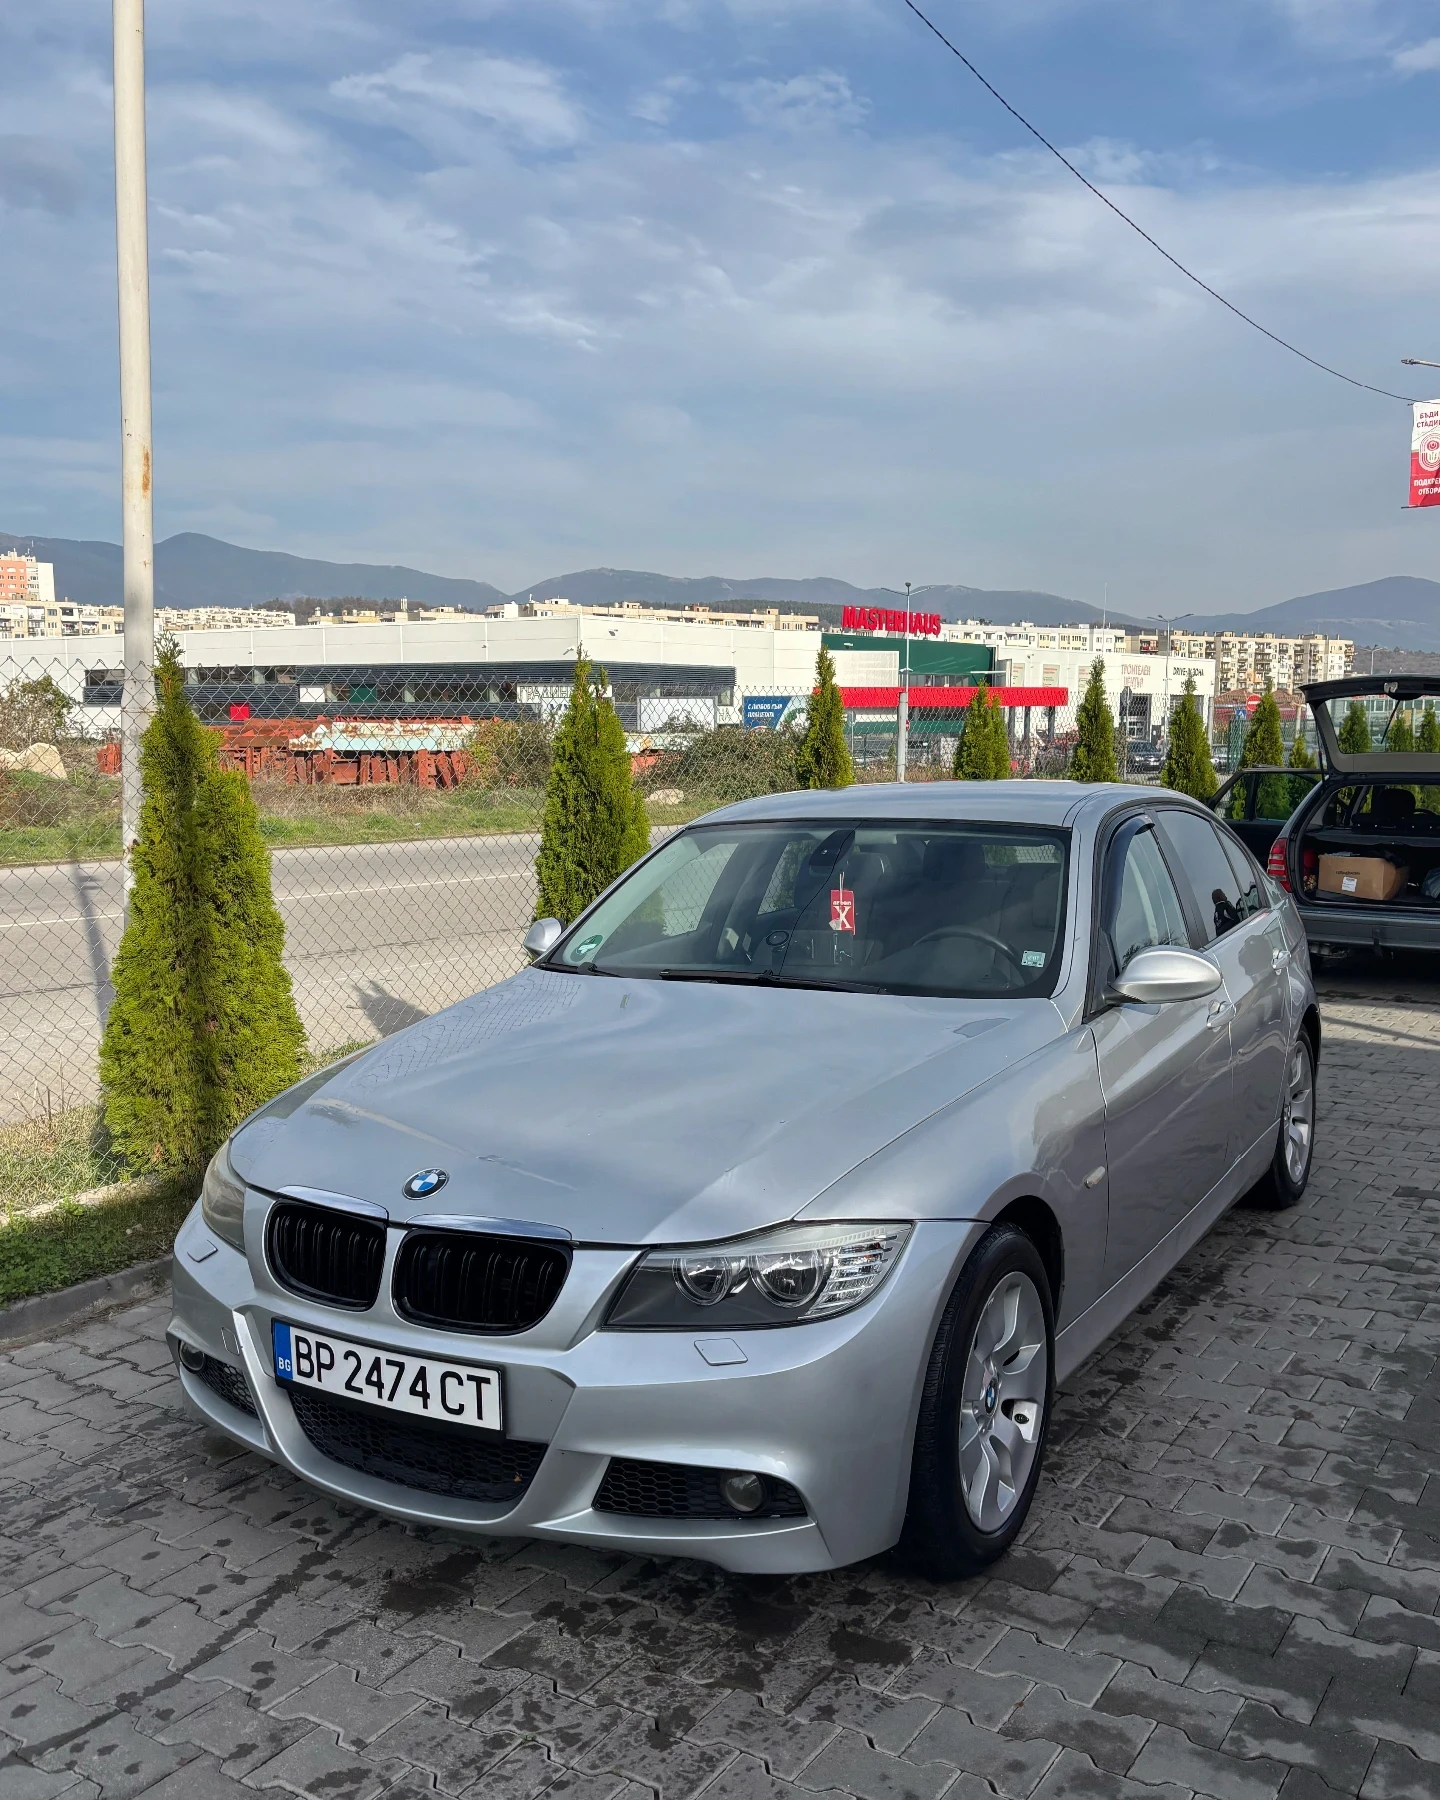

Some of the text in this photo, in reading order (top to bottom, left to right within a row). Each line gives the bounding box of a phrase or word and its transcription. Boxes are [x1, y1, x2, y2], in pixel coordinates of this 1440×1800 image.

[1419, 410, 1439, 419] БЪДИ
[1416, 419, 1440, 428] СТАДИ
[1414, 477, 1440, 487] ПОДКРЕ
[842, 605, 941, 636] MASTERHAUS
[832, 906, 853, 929] X
[278, 1357, 292, 1372] BG
[294, 1334, 491, 1421] BP 2474 CT
